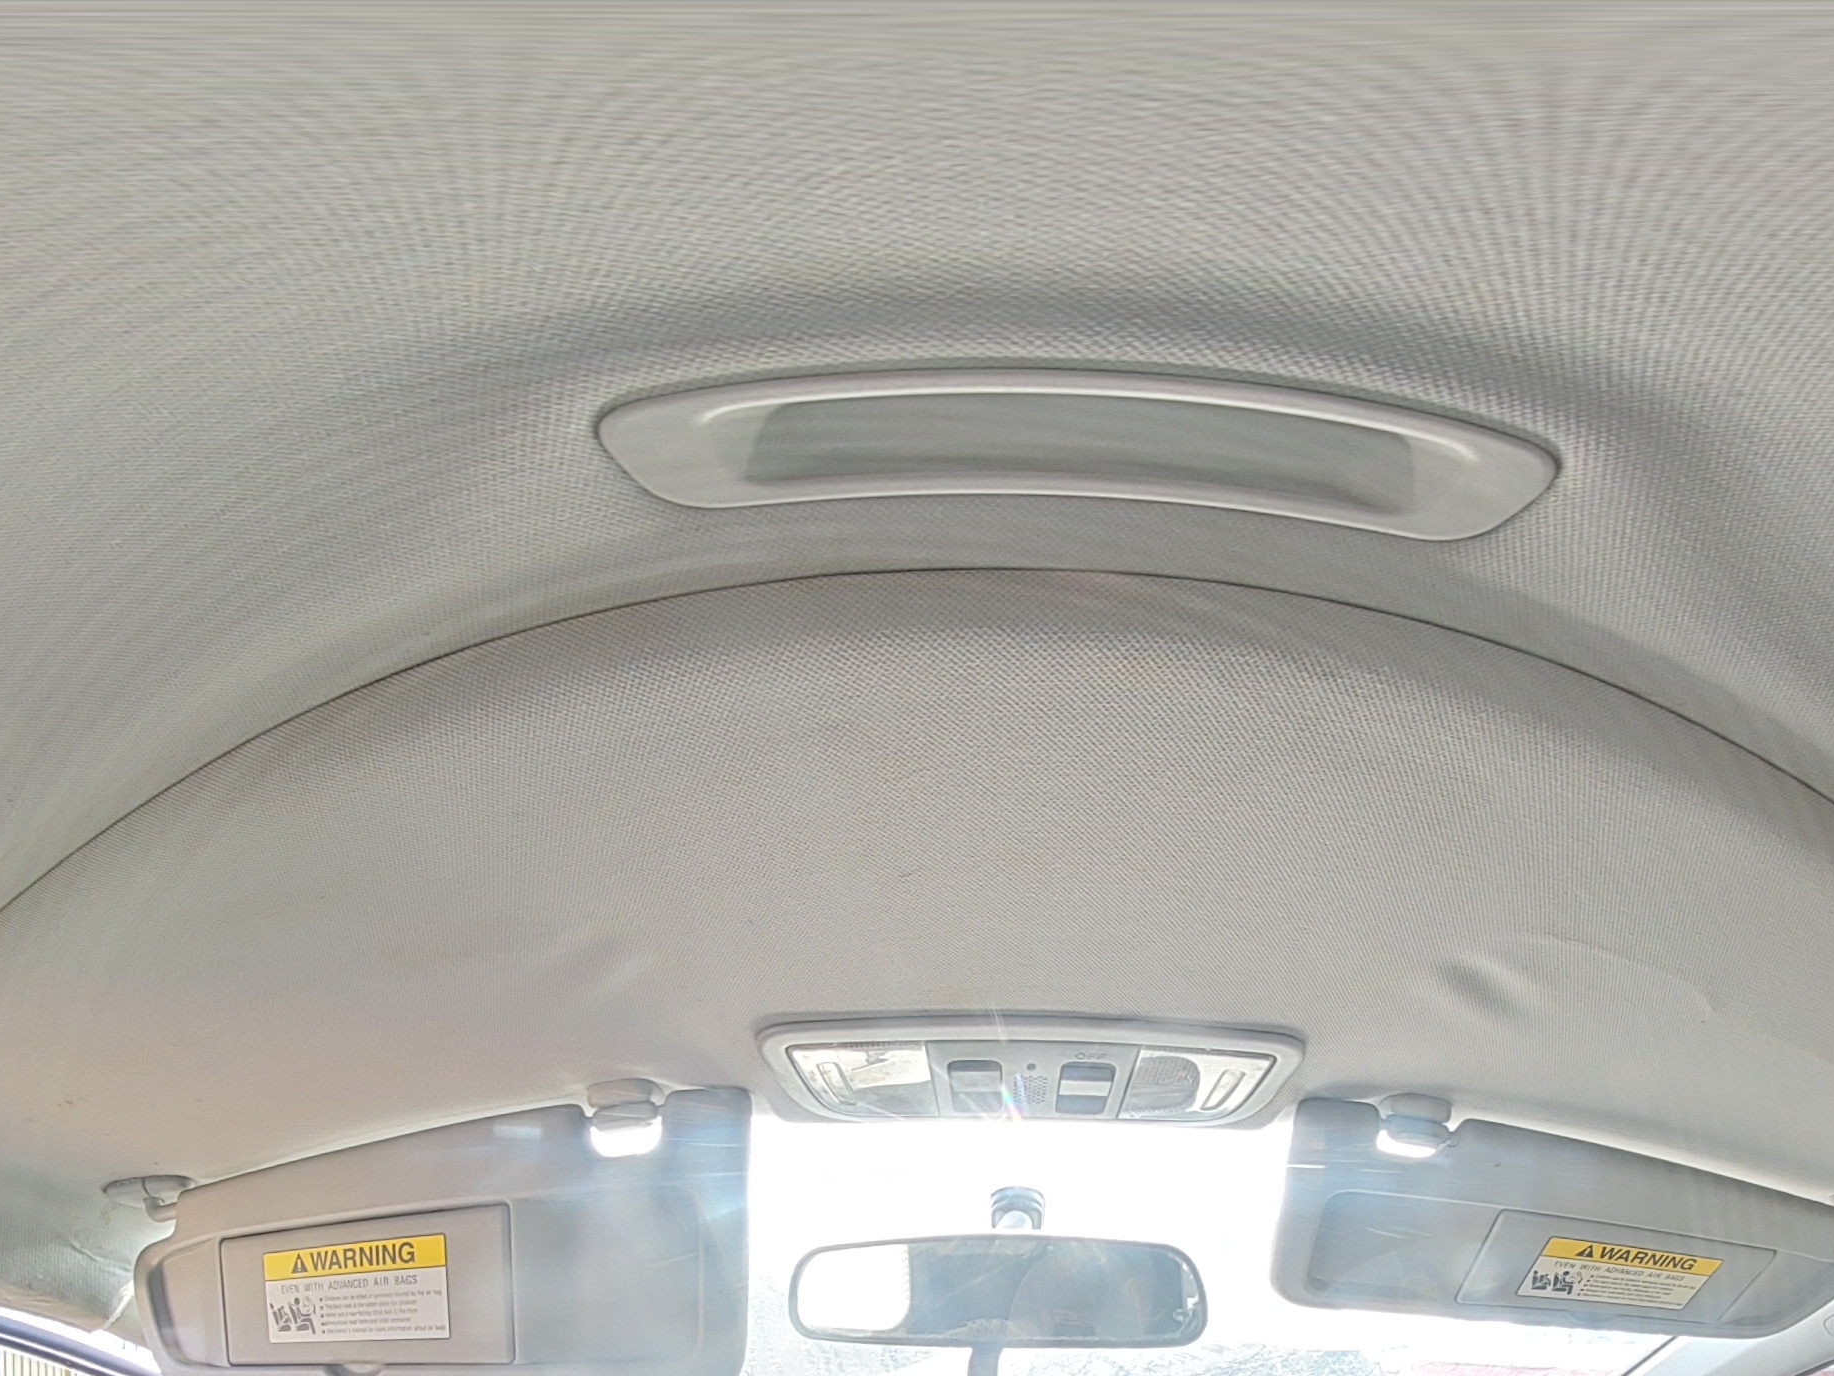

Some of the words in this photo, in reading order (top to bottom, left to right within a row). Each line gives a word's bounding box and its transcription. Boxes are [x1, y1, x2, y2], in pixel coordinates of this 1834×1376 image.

[310, 1242, 415, 1272] WARNING
[1599, 1246, 1697, 1271] WARNING
[1554, 1260, 1575, 1268] EVEN
[1580, 1264, 1601, 1272] WITH
[1605, 1266, 1645, 1277] ADVANCED
[1646, 1271, 1662, 1279] AIR
[1665, 1274, 1686, 1282] BAGS
[281, 1284, 299, 1294] EVEN
[305, 1282, 323, 1292] WITH
[328, 1279, 368, 1290] ADVANCED
[373, 1277, 389, 1286] AIR
[395, 1275, 418, 1285] BAGS
